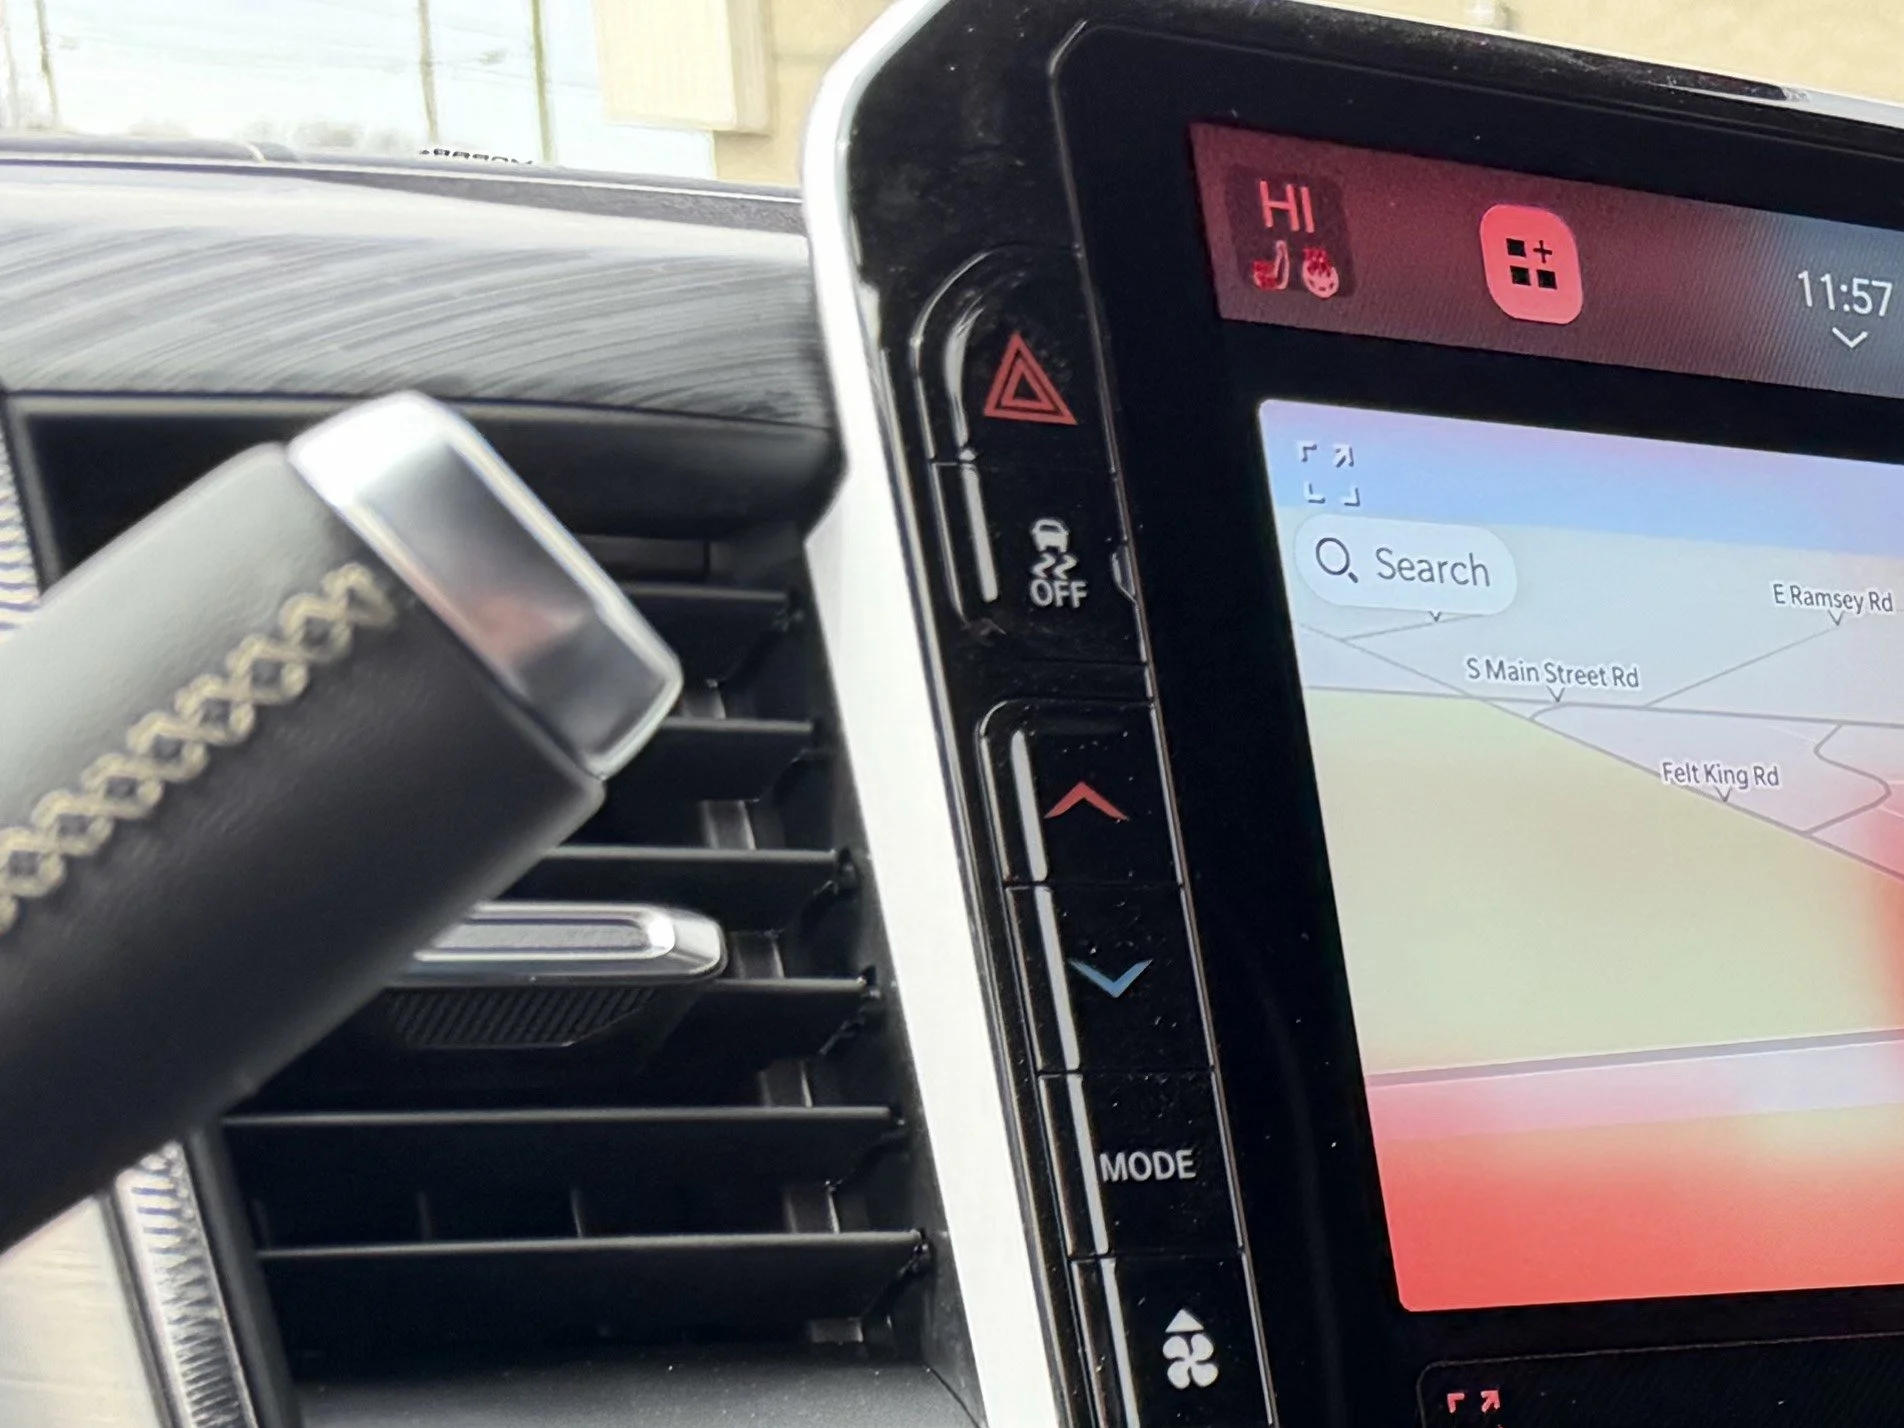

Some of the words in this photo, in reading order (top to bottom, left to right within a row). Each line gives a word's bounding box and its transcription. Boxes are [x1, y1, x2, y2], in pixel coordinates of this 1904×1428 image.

[1258, 179, 1316, 234] HI
[1797, 270, 1893, 318] 11:57
[1374, 546, 1492, 589] Search
[1029, 578, 1089, 609] OFF
[1773, 583, 1785, 605] E
[1788, 586, 1865, 615] Ramsey
[1868, 590, 1894, 614] Rd
[1466, 657, 1482, 681] S
[1485, 659, 1540, 683] Main
[1545, 662, 1608, 688] Street
[1612, 665, 1640, 689] Rd
[1662, 762, 1700, 785] Felt
[1703, 763, 1749, 791] King
[1754, 764, 1779, 788] Rd
[1098, 1149, 1197, 1184] MODE
